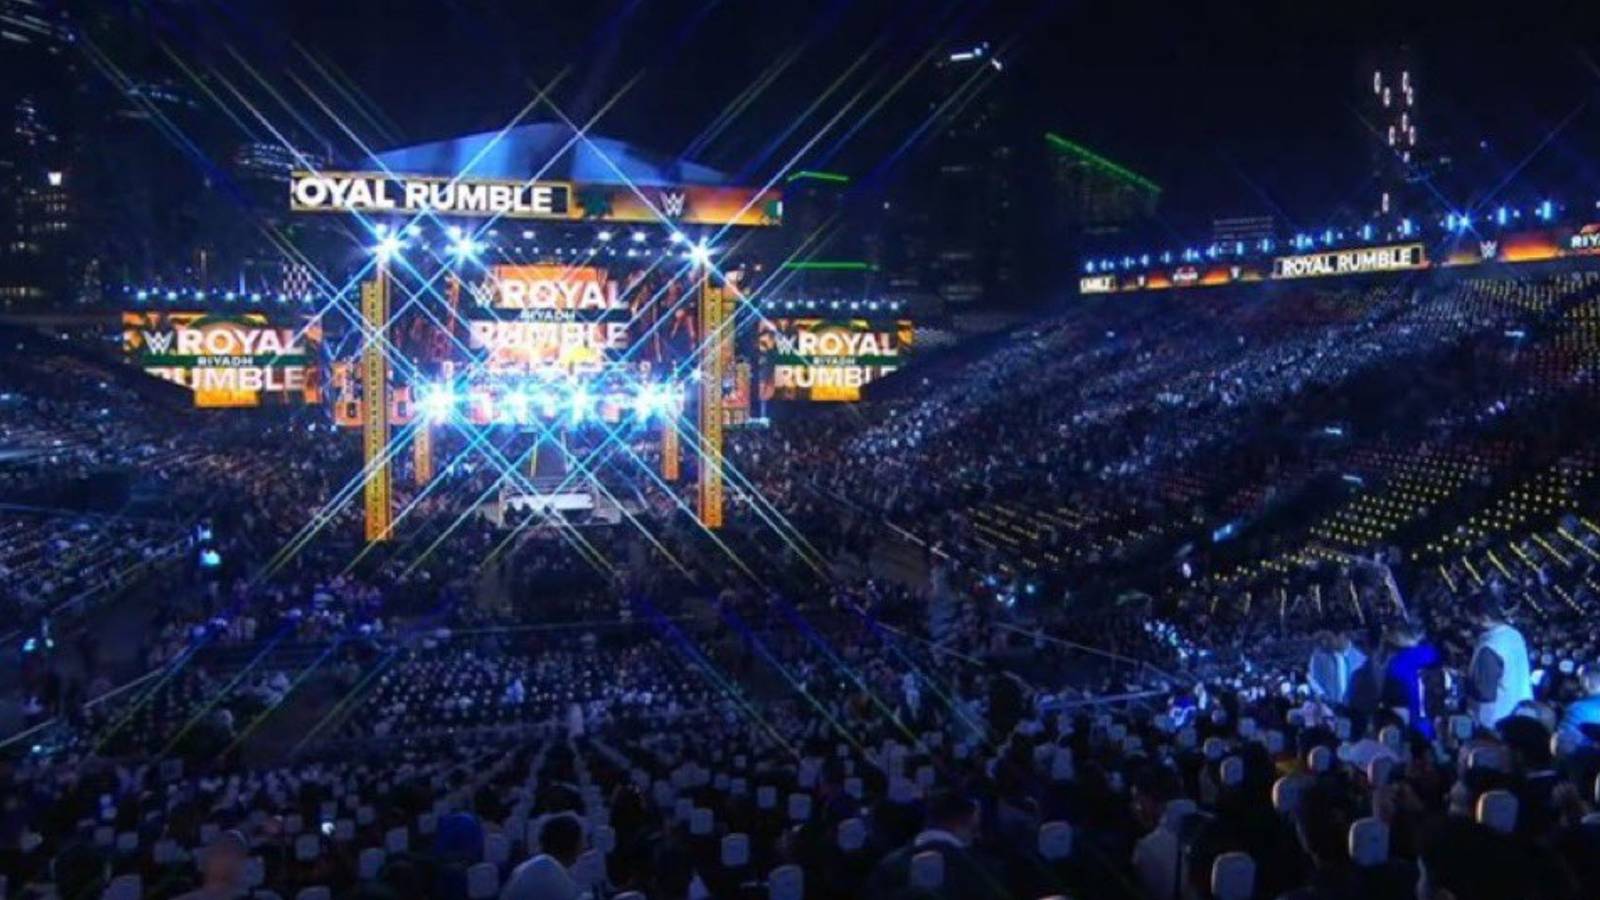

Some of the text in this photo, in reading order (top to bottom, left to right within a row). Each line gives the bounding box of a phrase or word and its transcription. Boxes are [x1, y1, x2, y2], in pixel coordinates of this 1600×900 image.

[292, 177, 553, 213] OYAL RUMBLE
[1571, 233, 1600, 248] RIY
[1282, 249, 1411, 274] ROYAL RUMBLE
[500, 279, 629, 309] ROYAL
[176, 329, 305, 356] ROYAL
[470, 321, 629, 349] RUMBLE
[798, 332, 898, 356] ROYAL
[197, 356, 254, 366] RIYADH
